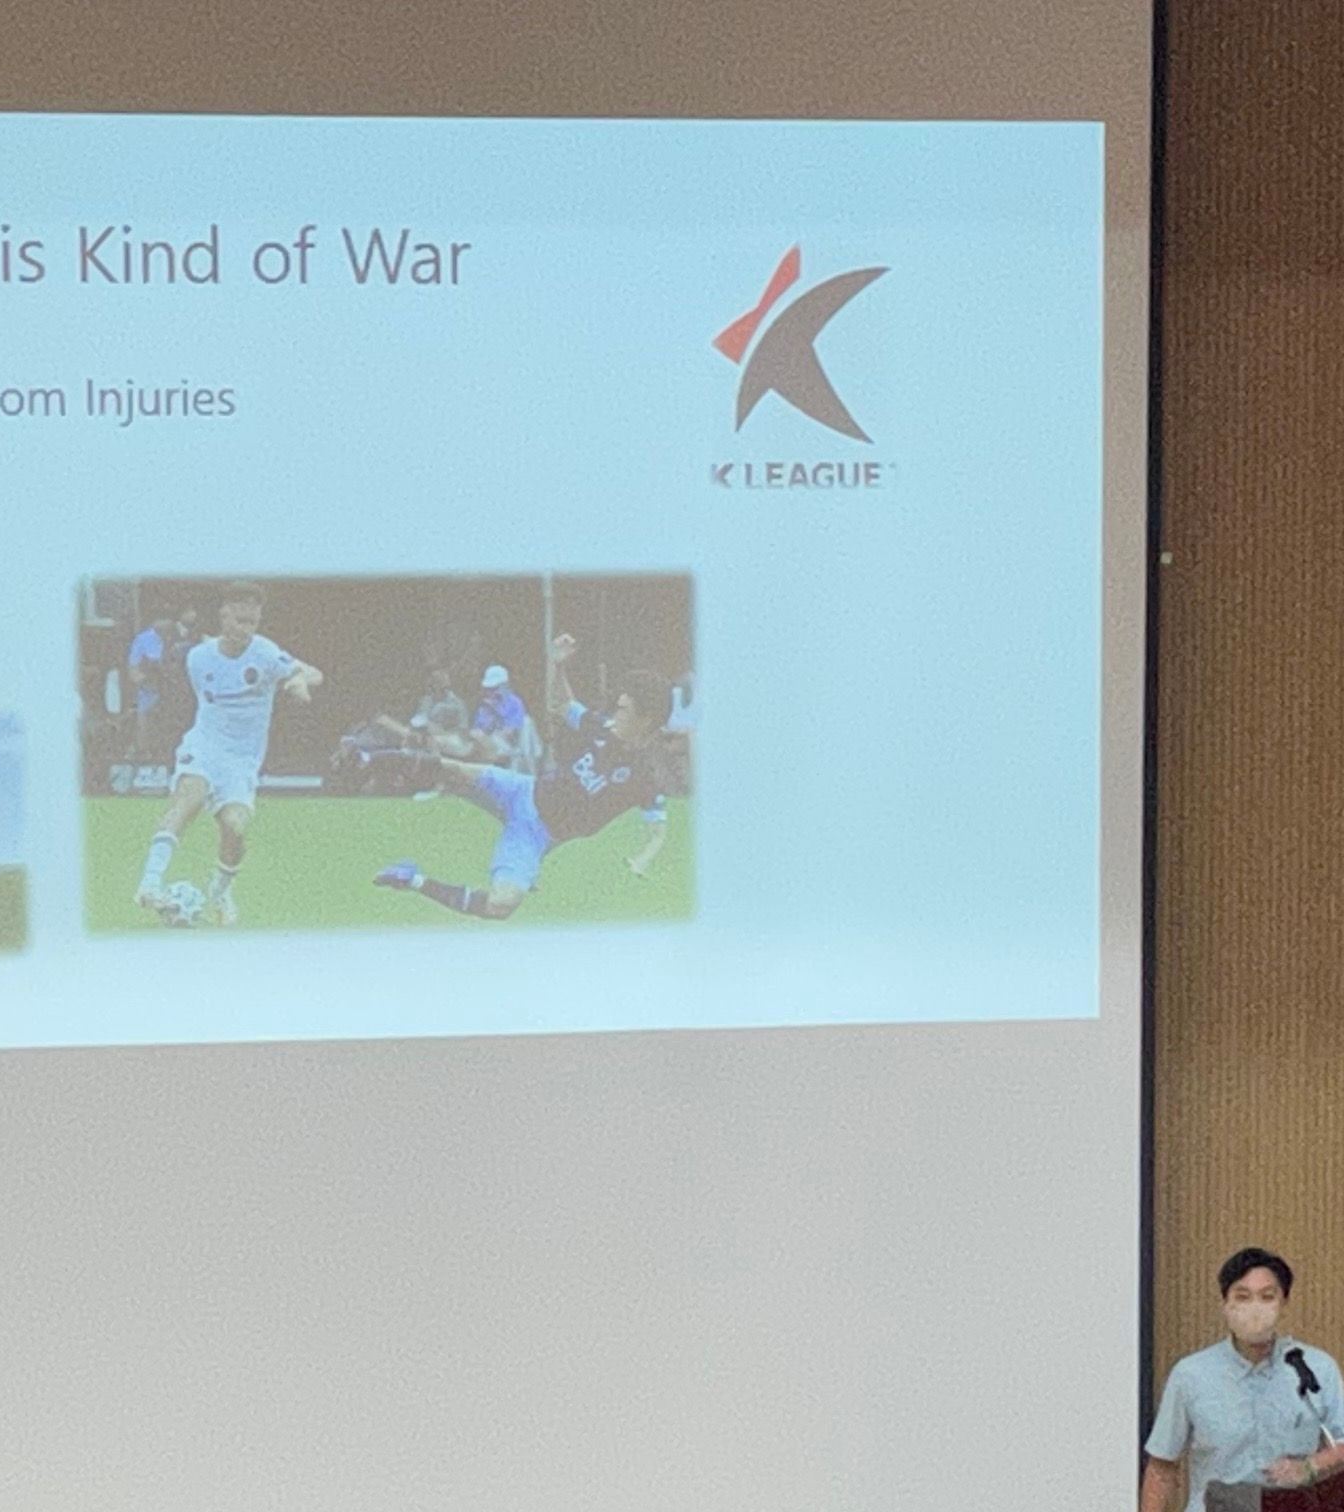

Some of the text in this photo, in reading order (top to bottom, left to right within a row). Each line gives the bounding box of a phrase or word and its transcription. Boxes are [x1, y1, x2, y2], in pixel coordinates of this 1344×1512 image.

[0, 223, 46, 284] is
[78, 223, 220, 285] Kind
[252, 223, 317, 285] of
[341, 226, 472, 286] War
[86, 378, 237, 428] Injuries
[710, 461, 884, 490] K LEAGUE
